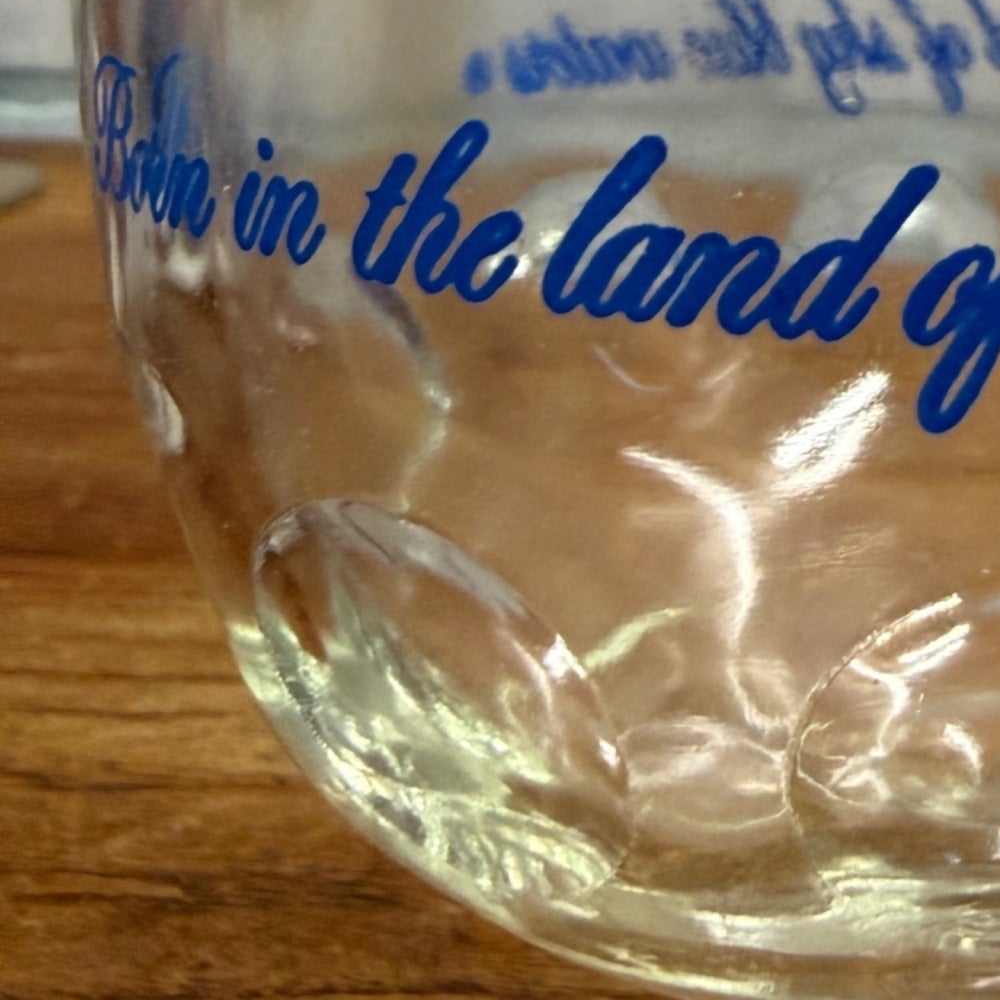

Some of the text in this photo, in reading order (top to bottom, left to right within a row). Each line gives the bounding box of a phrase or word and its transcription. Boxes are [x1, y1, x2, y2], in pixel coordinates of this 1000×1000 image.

[232, 137, 326, 266] in
[351, 118, 524, 304] the
[541, 134, 941, 343] land
